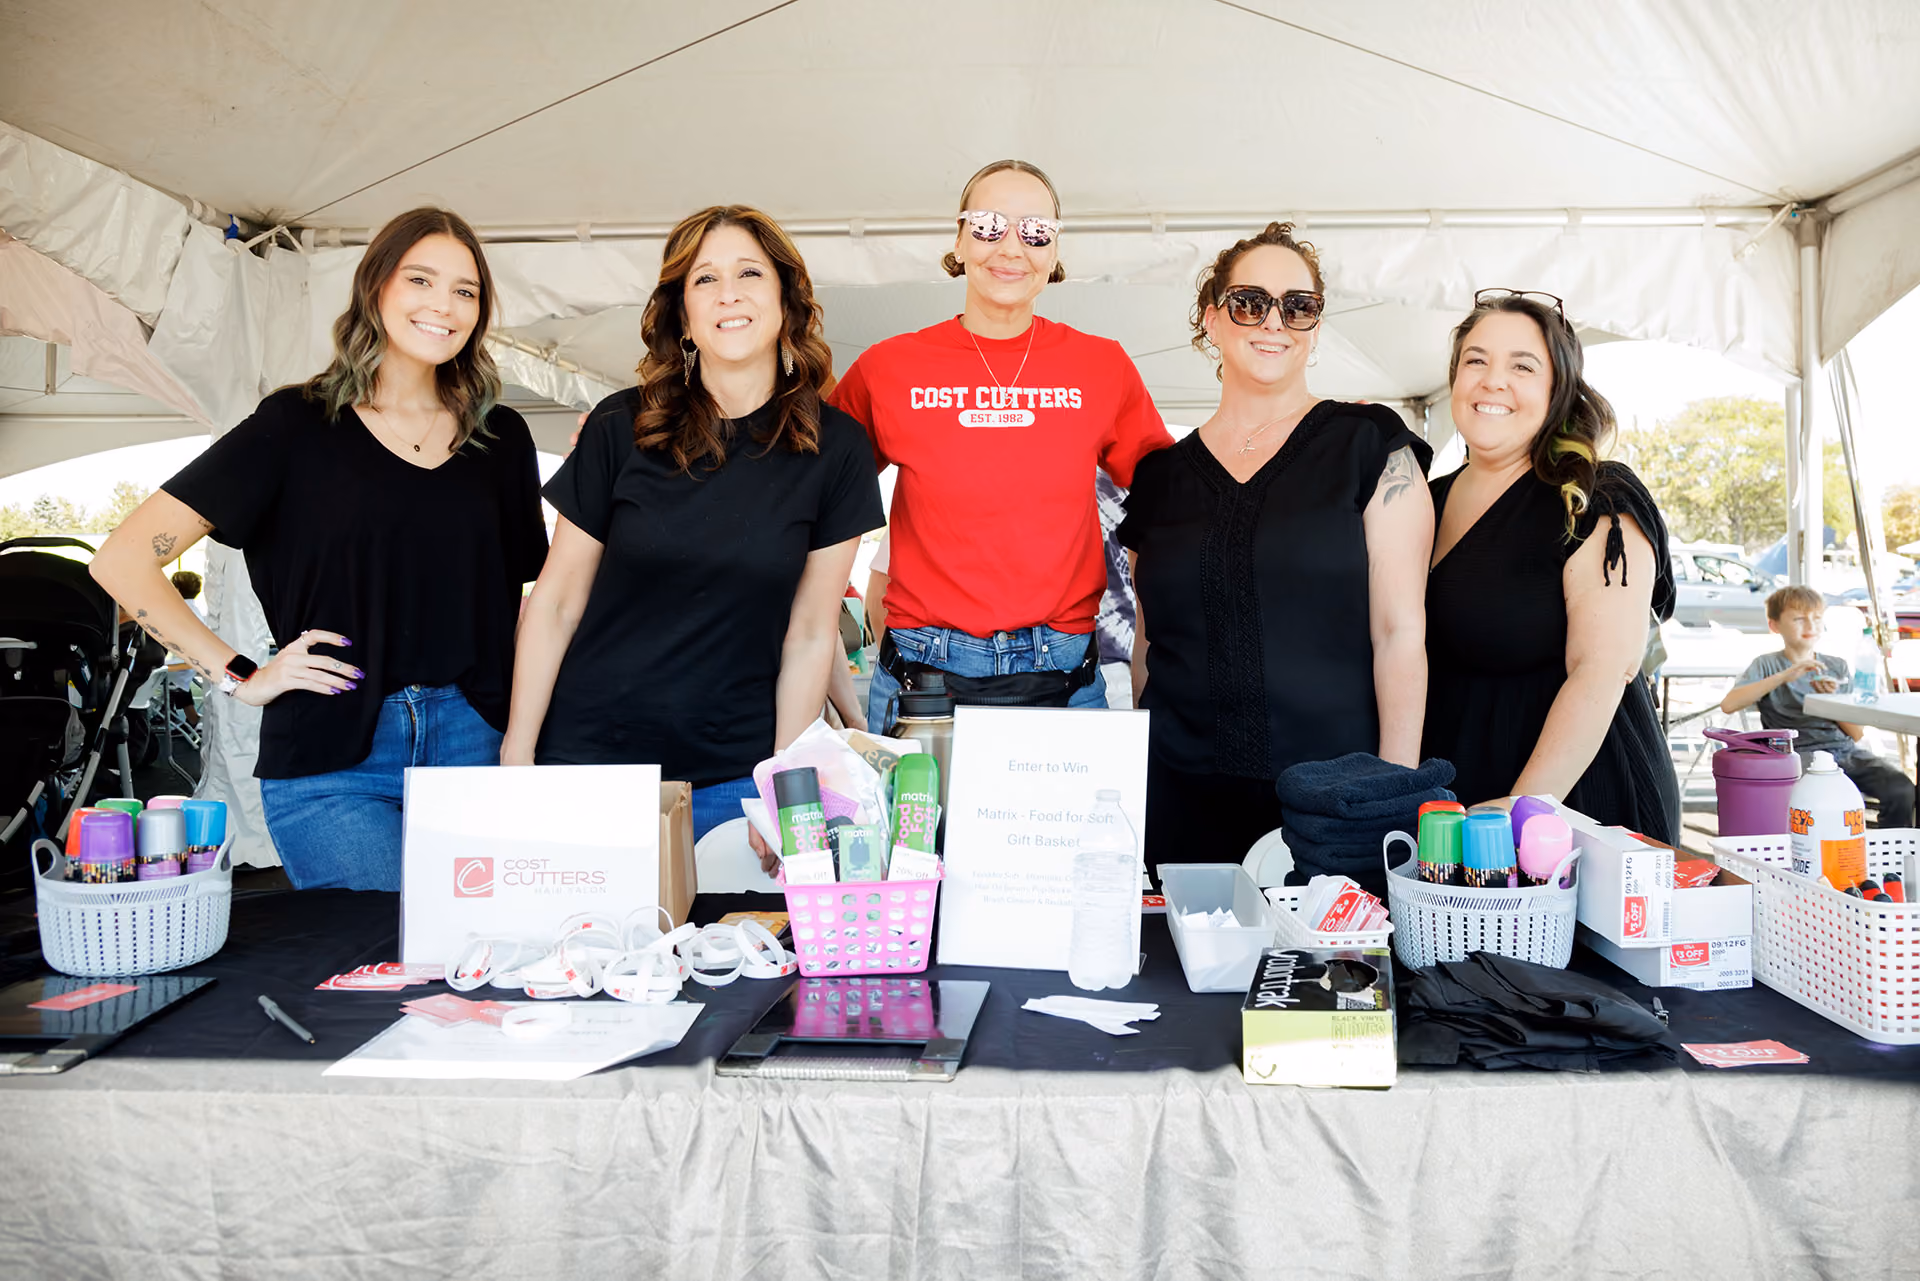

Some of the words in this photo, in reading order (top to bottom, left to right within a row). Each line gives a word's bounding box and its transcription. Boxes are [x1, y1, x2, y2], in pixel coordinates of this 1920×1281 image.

[910, 387, 968, 409] COST
[976, 386, 1082, 409] CUTTERS
[970, 414, 995, 423] EST.
[998, 414, 1024, 423] 1982
[1008, 759, 1042, 772] Enter
[1046, 762, 1060, 773] to
[1062, 761, 1088, 774] Win
[910, 804, 925, 833] For
[976, 808, 1018, 822] Matrix
[1029, 809, 1062, 822] Food
[1066, 810, 1083, 823] for
[1086, 812, 1114, 824] Soft
[1007, 833, 1031, 846] Gift
[1034, 834, 1082, 848] Basket
[503, 859, 550, 870] COST
[503, 871, 606, 886] CUTTERS
[1630, 902, 1639, 921] OFF
[1686, 950, 1704, 958] OFF
